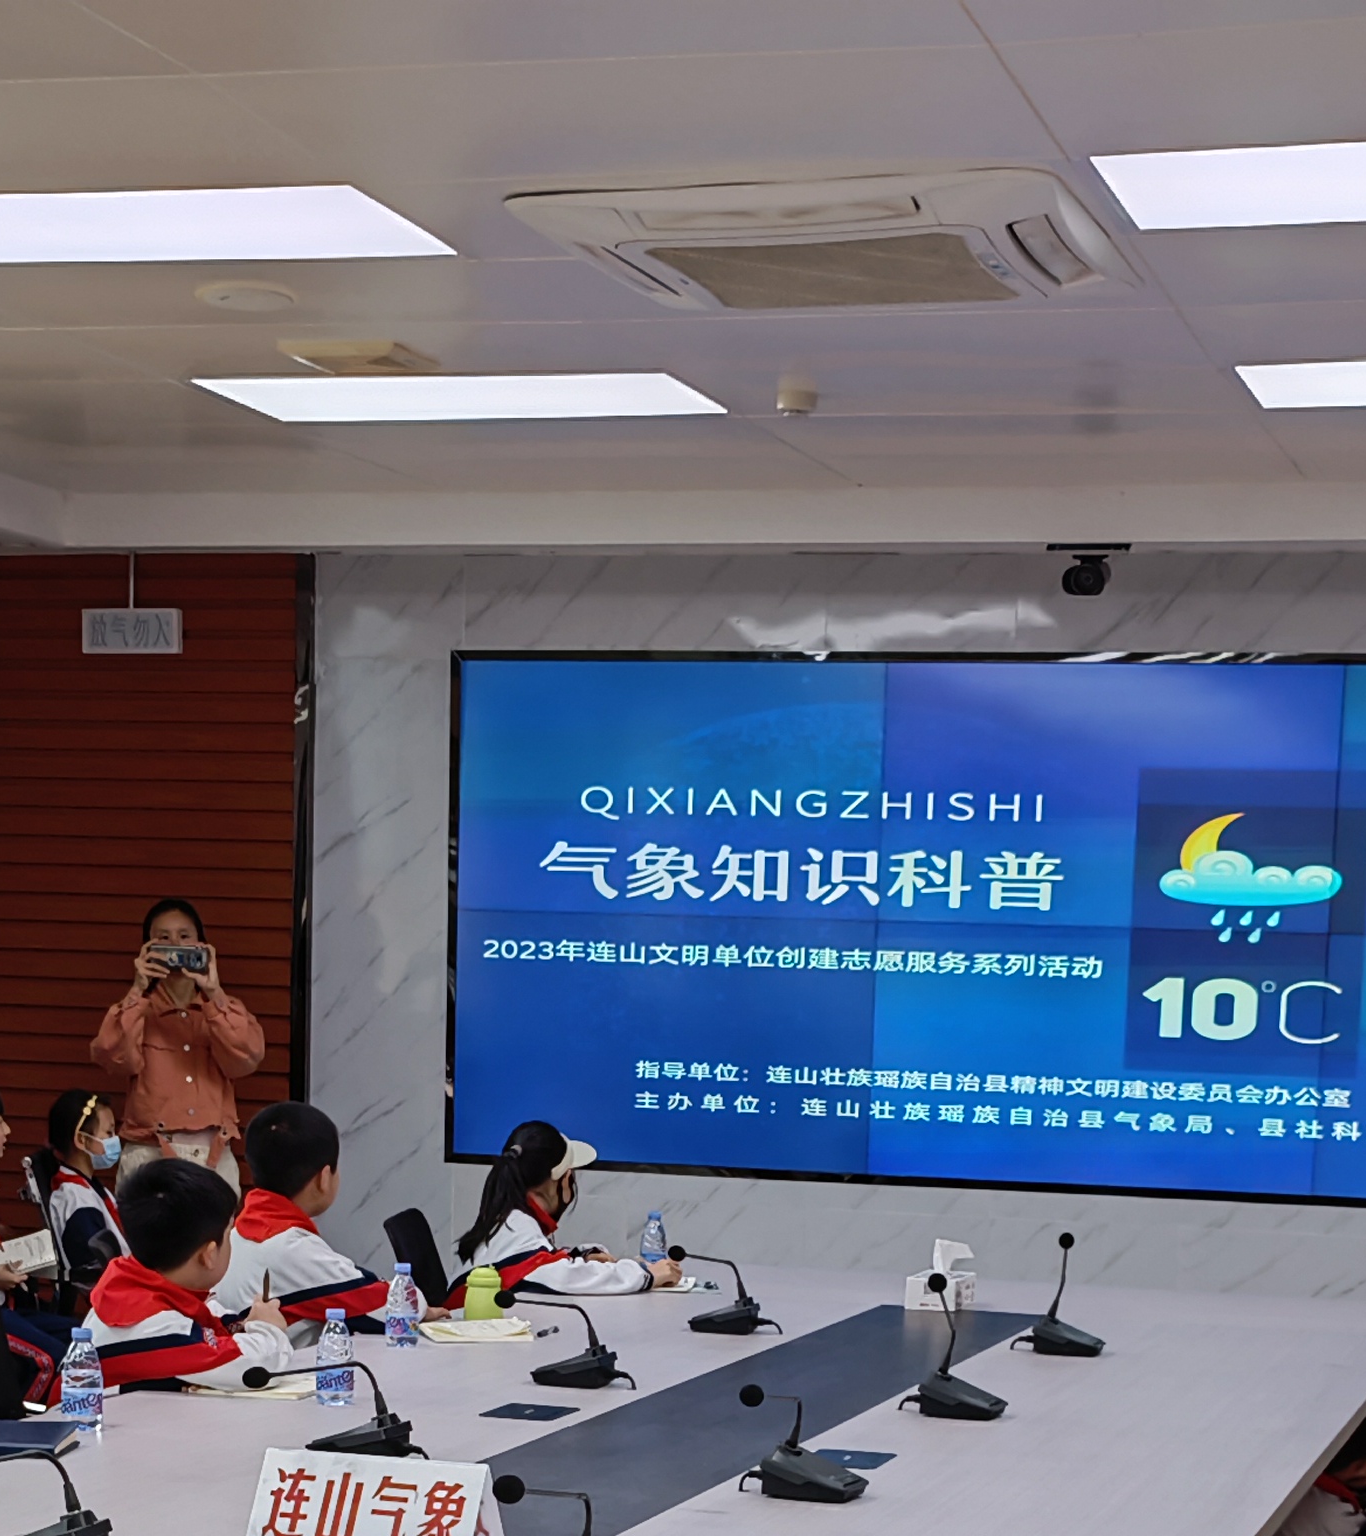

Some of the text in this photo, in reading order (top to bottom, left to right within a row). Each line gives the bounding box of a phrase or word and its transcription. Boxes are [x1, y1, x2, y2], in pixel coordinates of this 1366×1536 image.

[580, 785, 1046, 823] QIXIANGZHISHI
[539, 840, 1064, 912] 气象知识科普
[482, 938, 1104, 980] 2023年连山文明单位创建志愿服务系列活动
